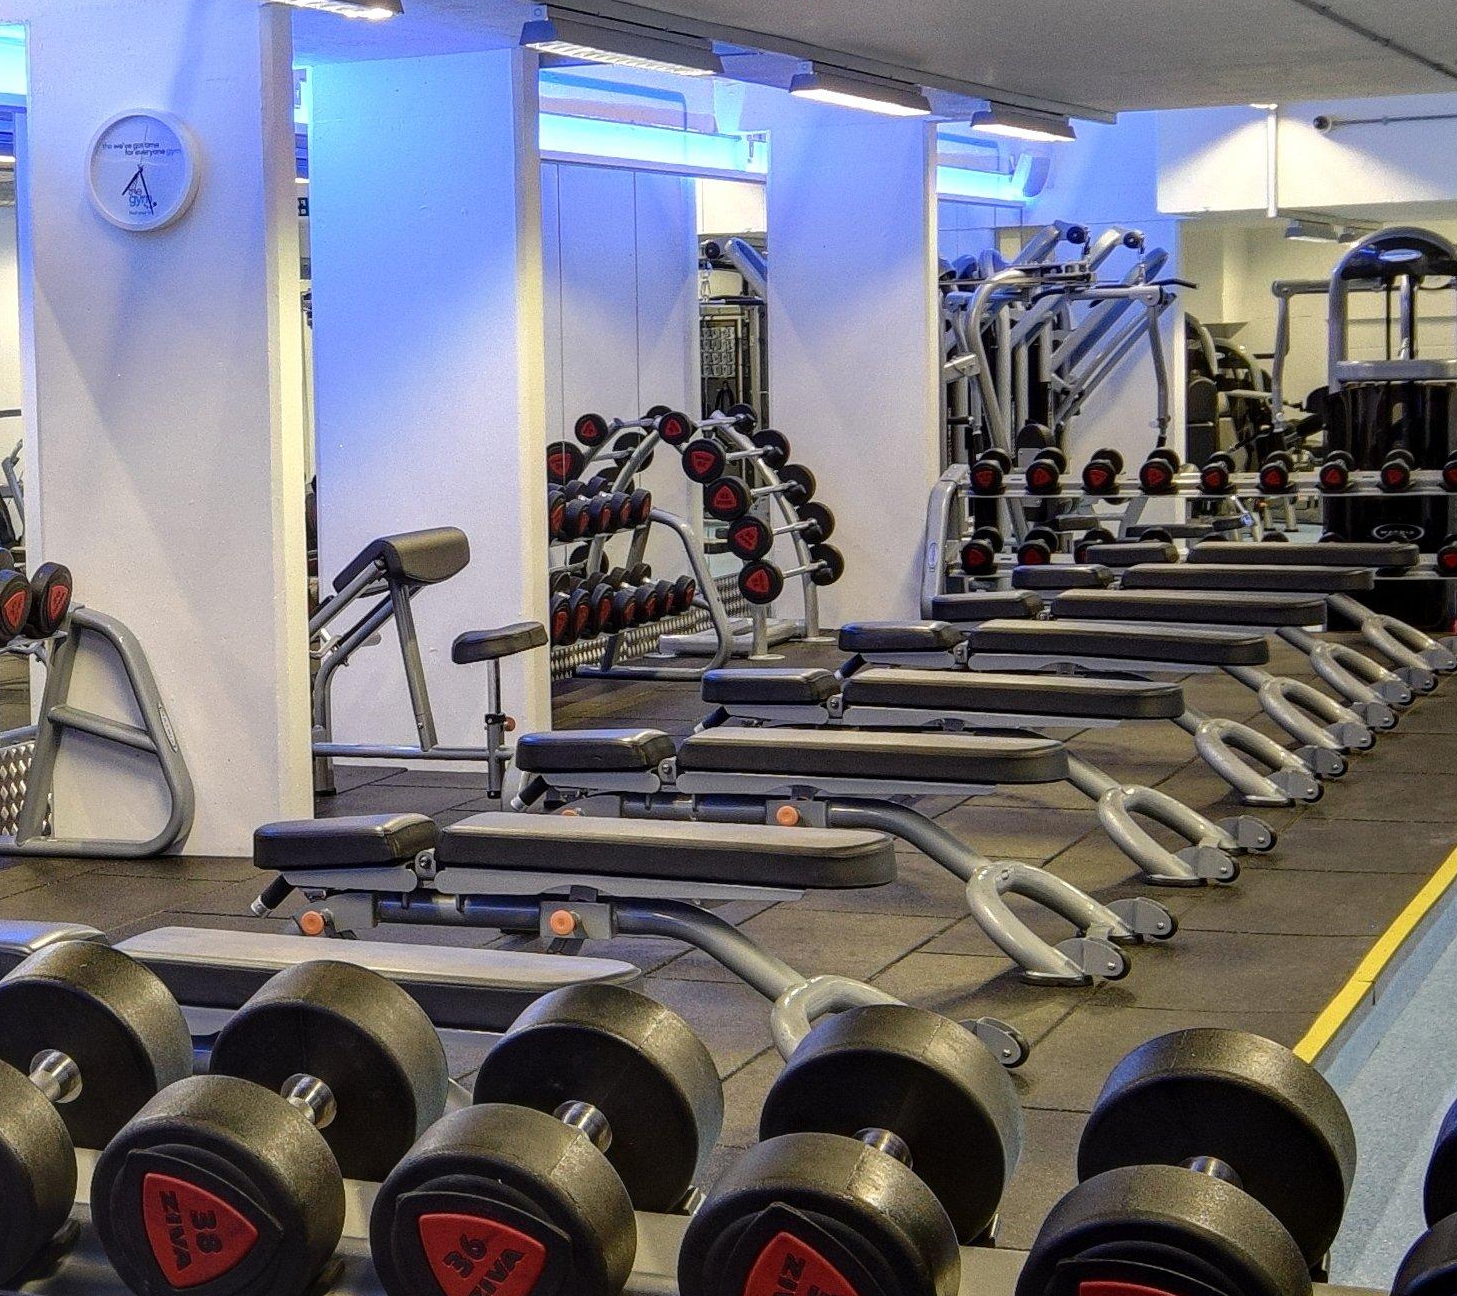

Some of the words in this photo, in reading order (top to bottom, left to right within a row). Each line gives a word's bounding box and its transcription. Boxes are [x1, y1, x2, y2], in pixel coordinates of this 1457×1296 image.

[158, 1188, 195, 1273] ZIVA
[188, 1208, 224, 1256] 38
[441, 1233, 487, 1280] 36
